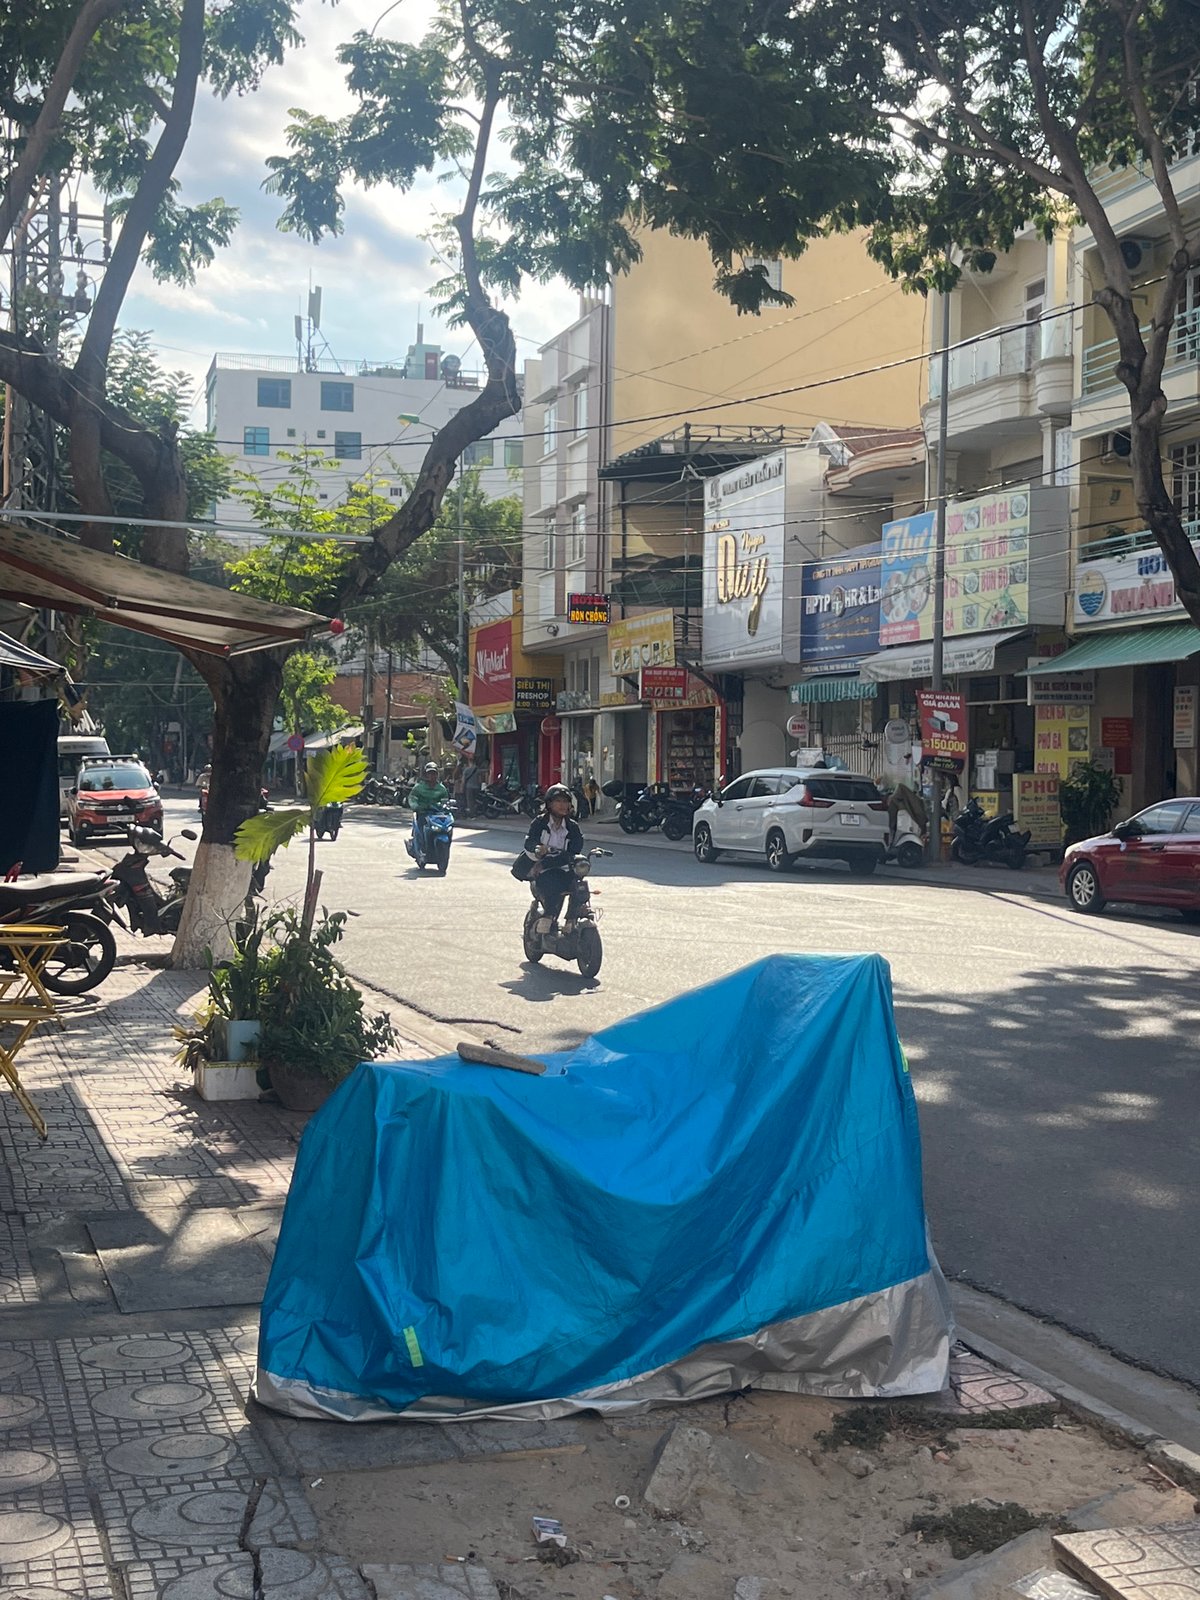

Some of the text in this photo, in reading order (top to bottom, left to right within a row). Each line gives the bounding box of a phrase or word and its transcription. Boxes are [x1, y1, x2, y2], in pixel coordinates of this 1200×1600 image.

[806, 594, 831, 615] HPTP
[845, 588, 858, 609] HR
[517, 692, 549, 700] FRESHOP
[930, 738, 966, 752] 150.000
